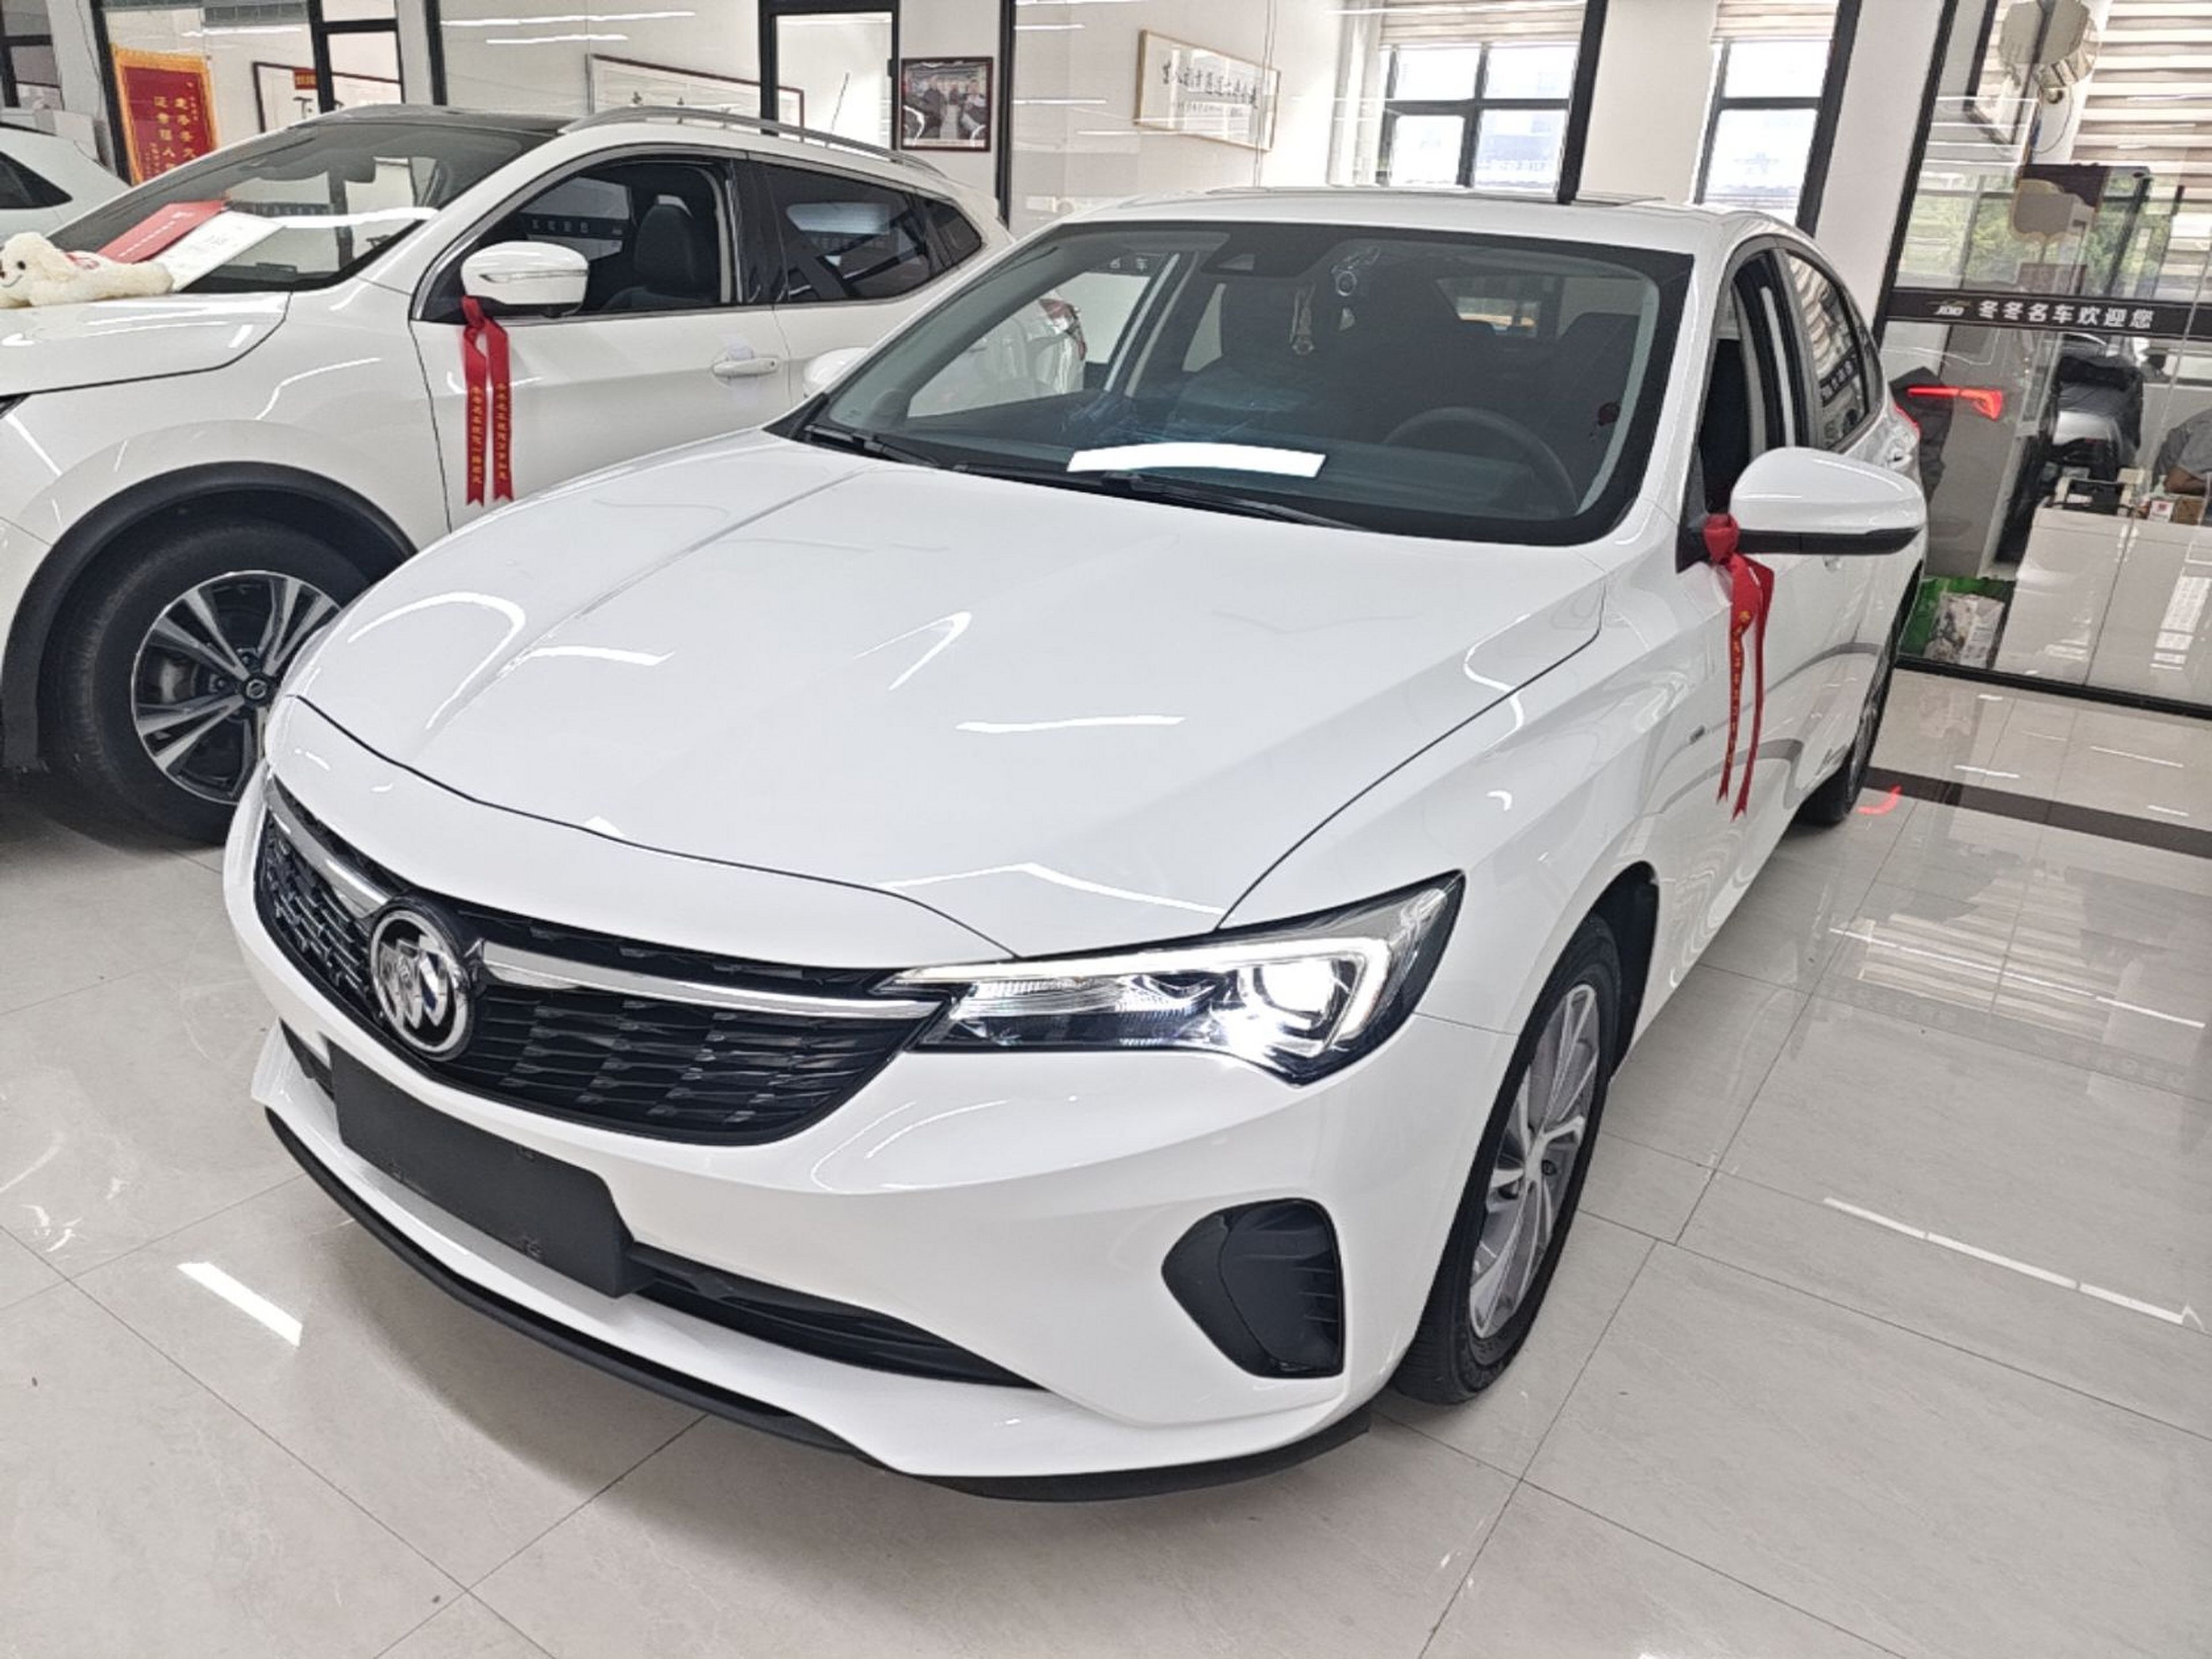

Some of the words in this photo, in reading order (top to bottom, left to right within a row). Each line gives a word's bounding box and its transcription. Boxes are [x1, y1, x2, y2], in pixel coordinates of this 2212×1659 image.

[1979, 300, 2154, 329] 冬冬名车欢迎您
